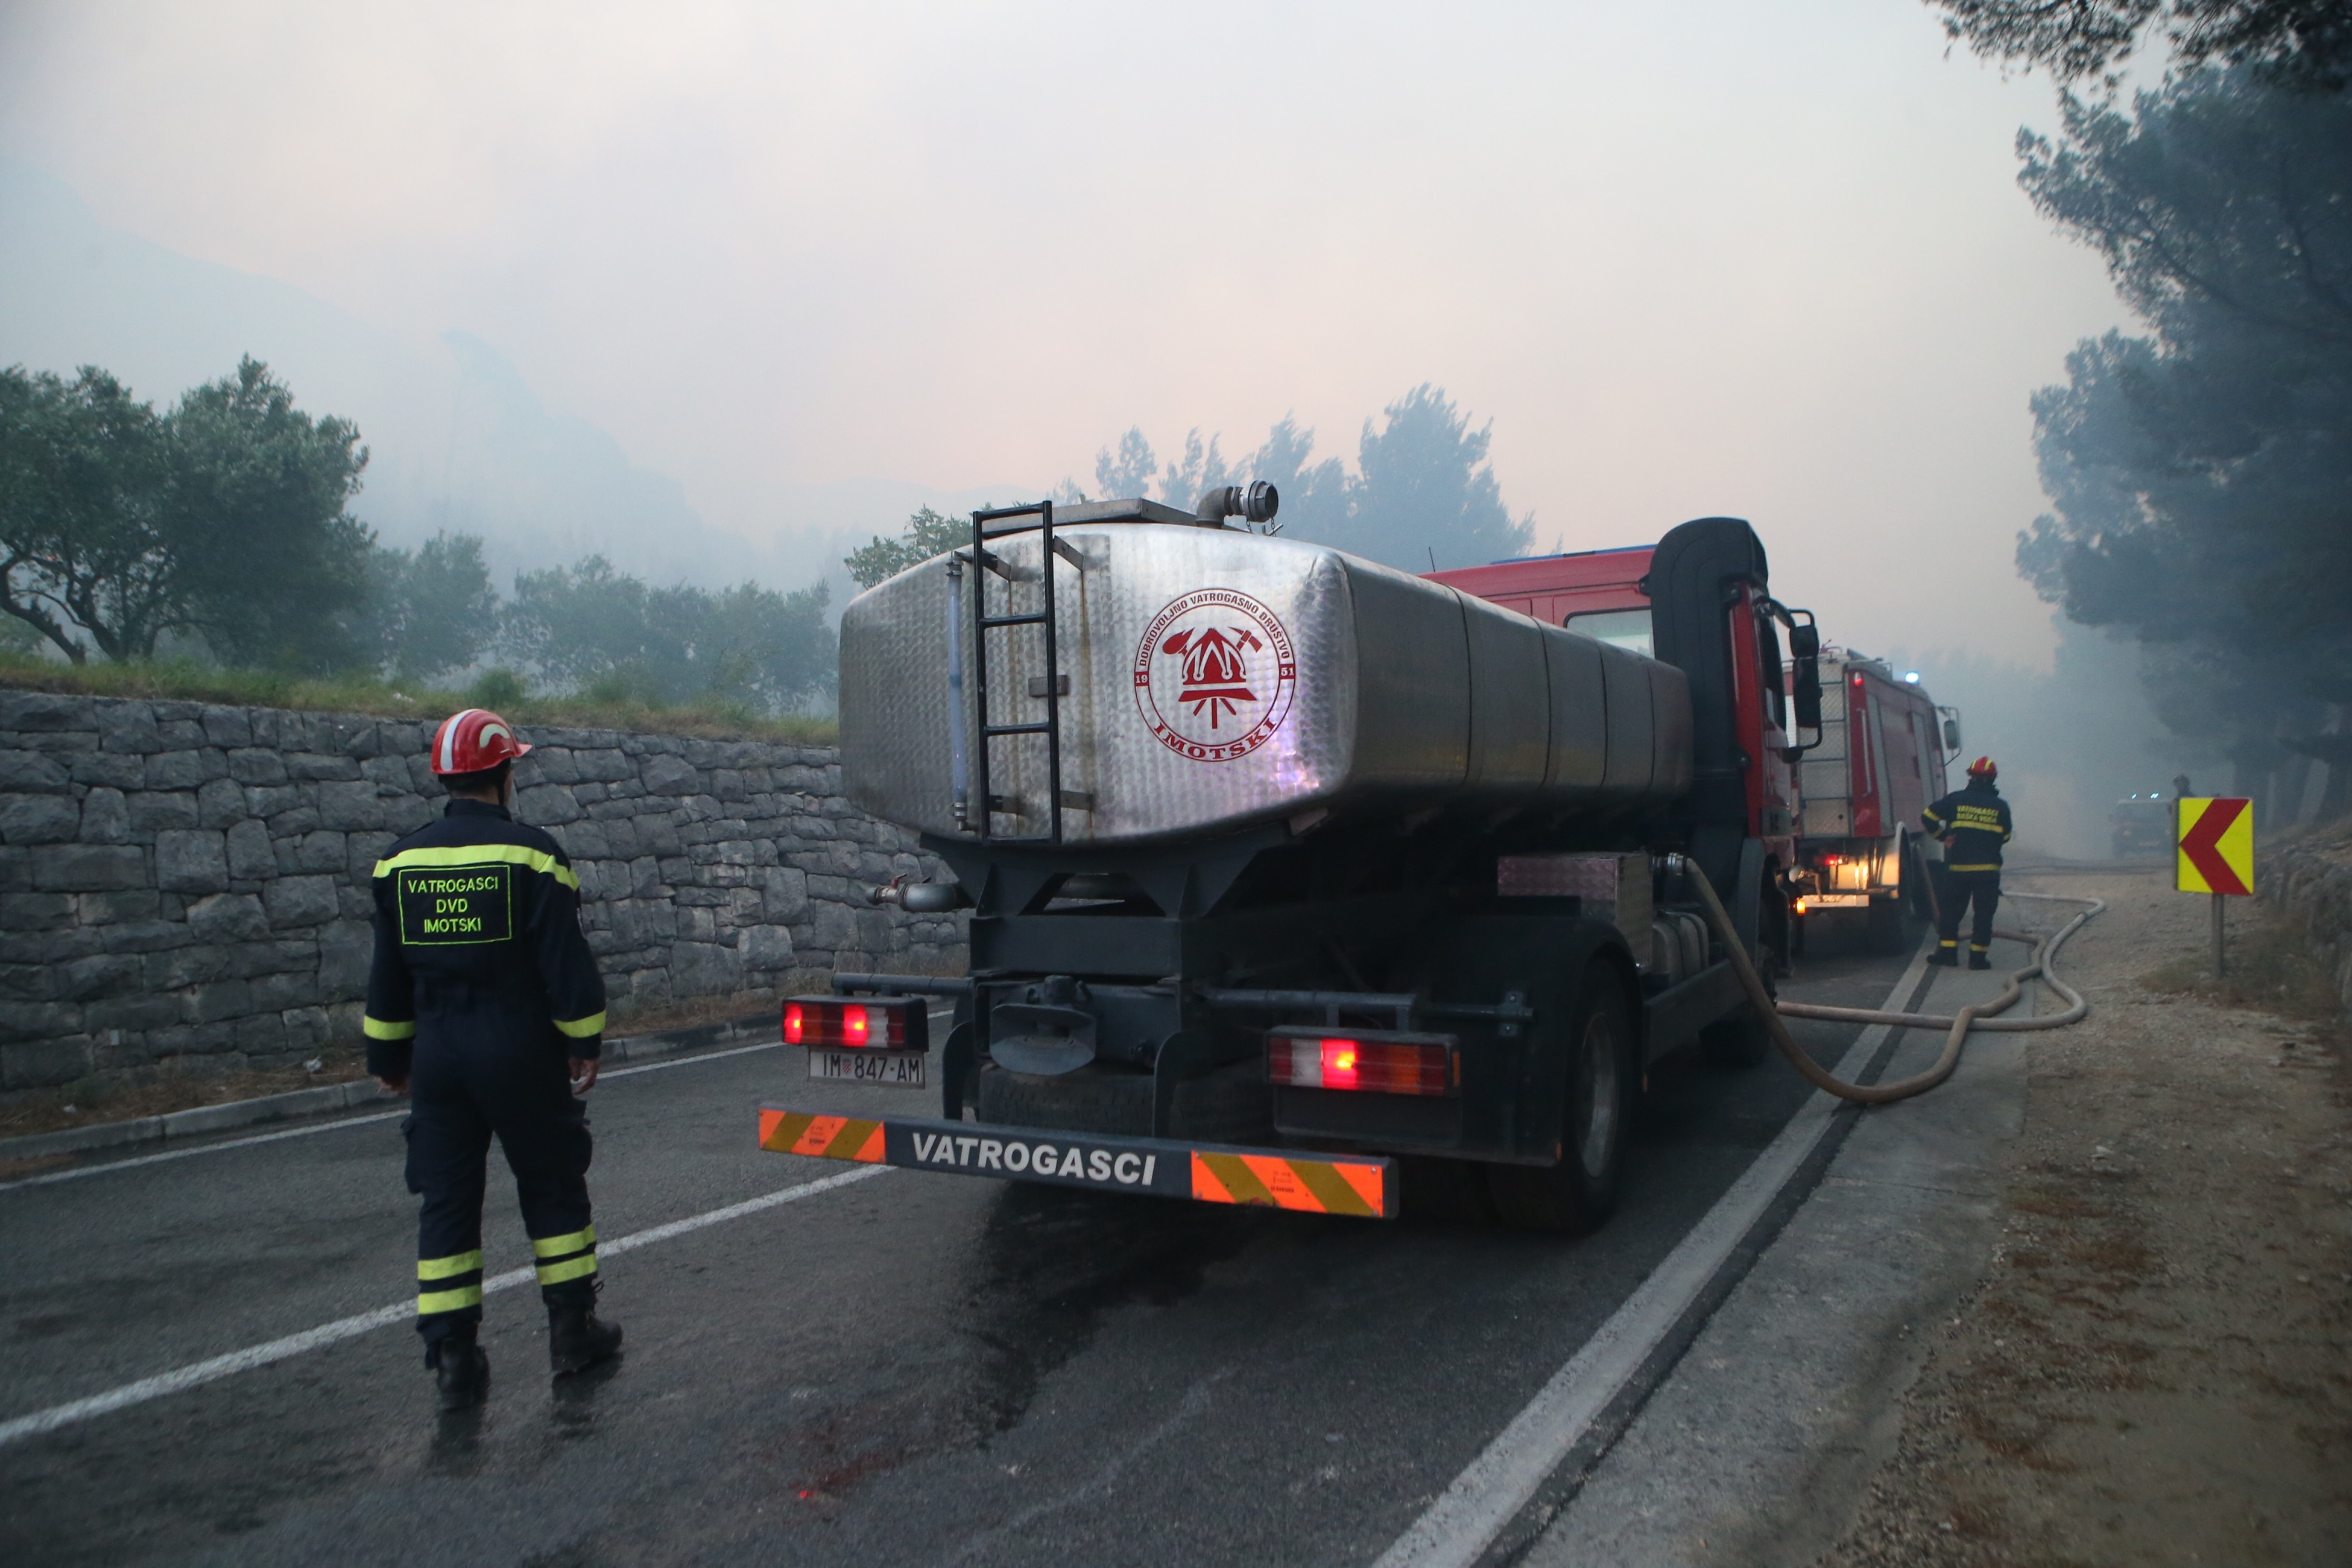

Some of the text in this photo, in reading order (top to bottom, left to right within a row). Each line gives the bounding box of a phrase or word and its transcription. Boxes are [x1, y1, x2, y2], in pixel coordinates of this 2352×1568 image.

[1139, 593, 1289, 666] DOBROVOLJNO VATROGASNO DRUŠTVO
[1136, 675, 1148, 683] 19
[1281, 667, 1294, 676] 51
[1153, 718, 1277, 759] IMOTSKI
[408, 876, 499, 893] VATROGASCI
[436, 898, 468, 913] DVD
[424, 917, 482, 933] IMOTSKI
[824, 1054, 920, 1083] IM 847-AM
[912, 1133, 1156, 1186] VATROGASCI
